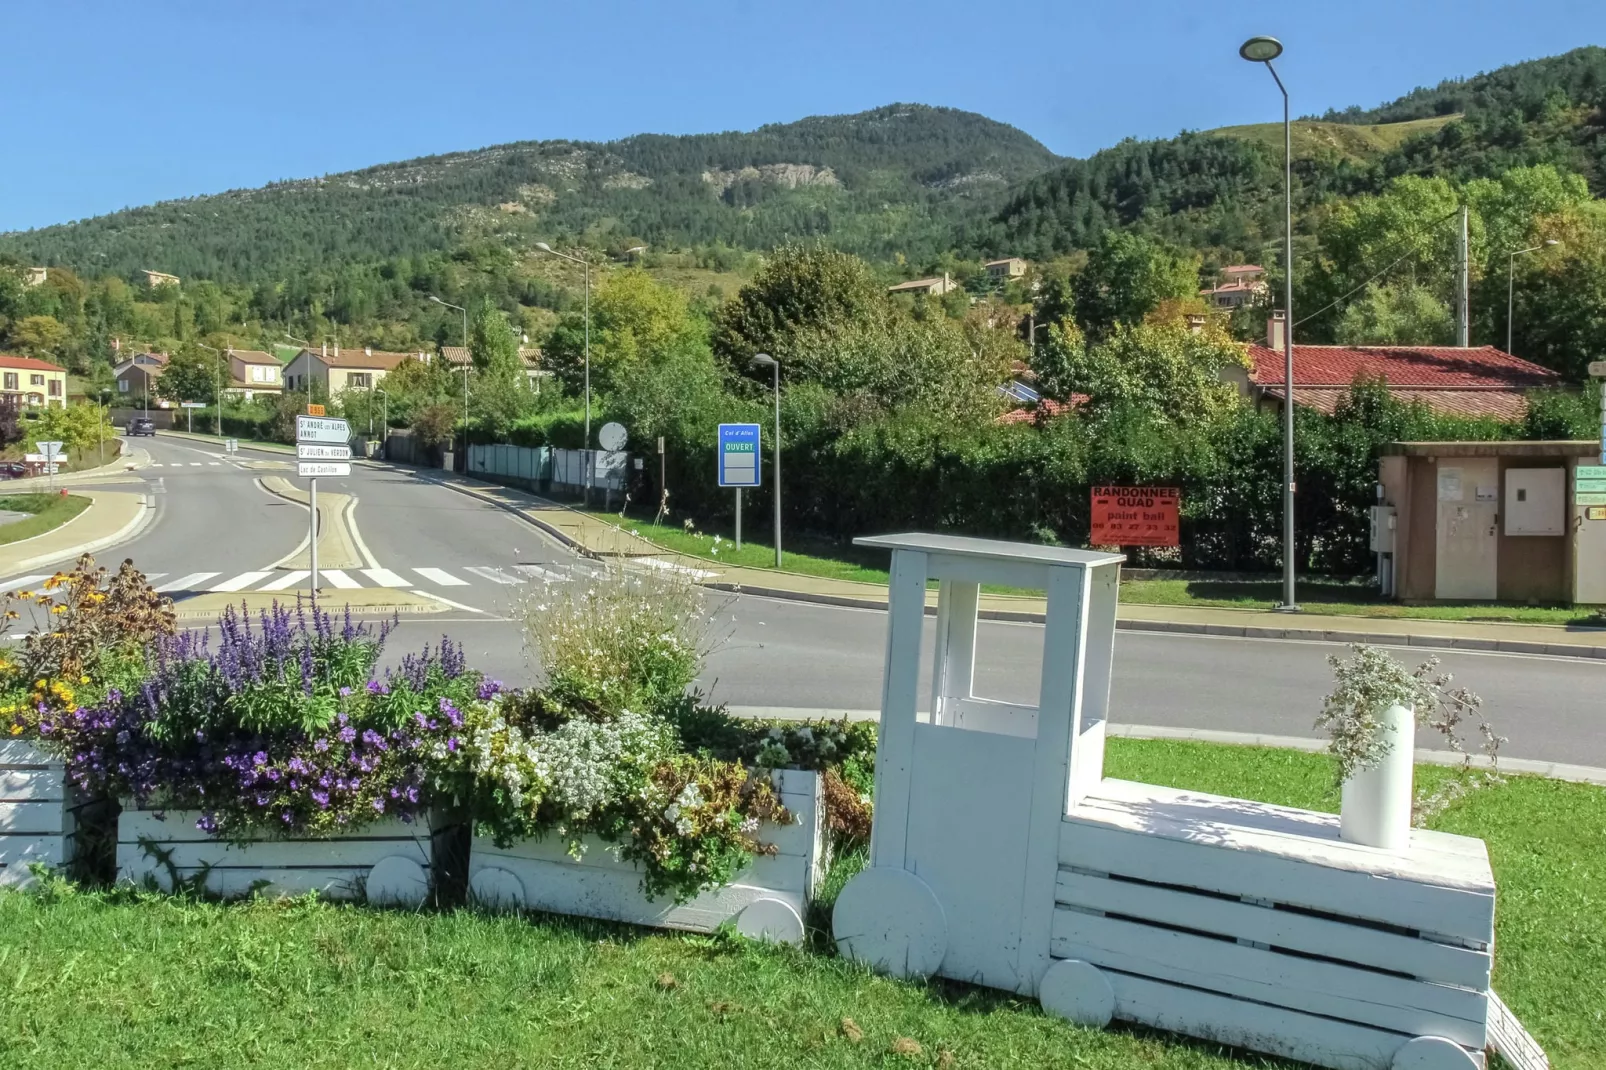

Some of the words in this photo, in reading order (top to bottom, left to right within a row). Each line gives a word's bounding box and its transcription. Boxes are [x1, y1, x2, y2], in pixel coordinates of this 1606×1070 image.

[307, 421, 323, 430] ANDRÉ
[331, 423, 346, 432] ALPES
[300, 430, 317, 438] ANNOT
[725, 443, 754, 451] OUVERT
[307, 448, 324, 456] JULIEN
[331, 449, 349, 457] VERDON
[1093, 487, 1177, 498] RANDONNEE
[1117, 497, 1154, 508] QUAD
[1107, 511, 1138, 521] paint
[1143, 512, 1165, 521] ball
